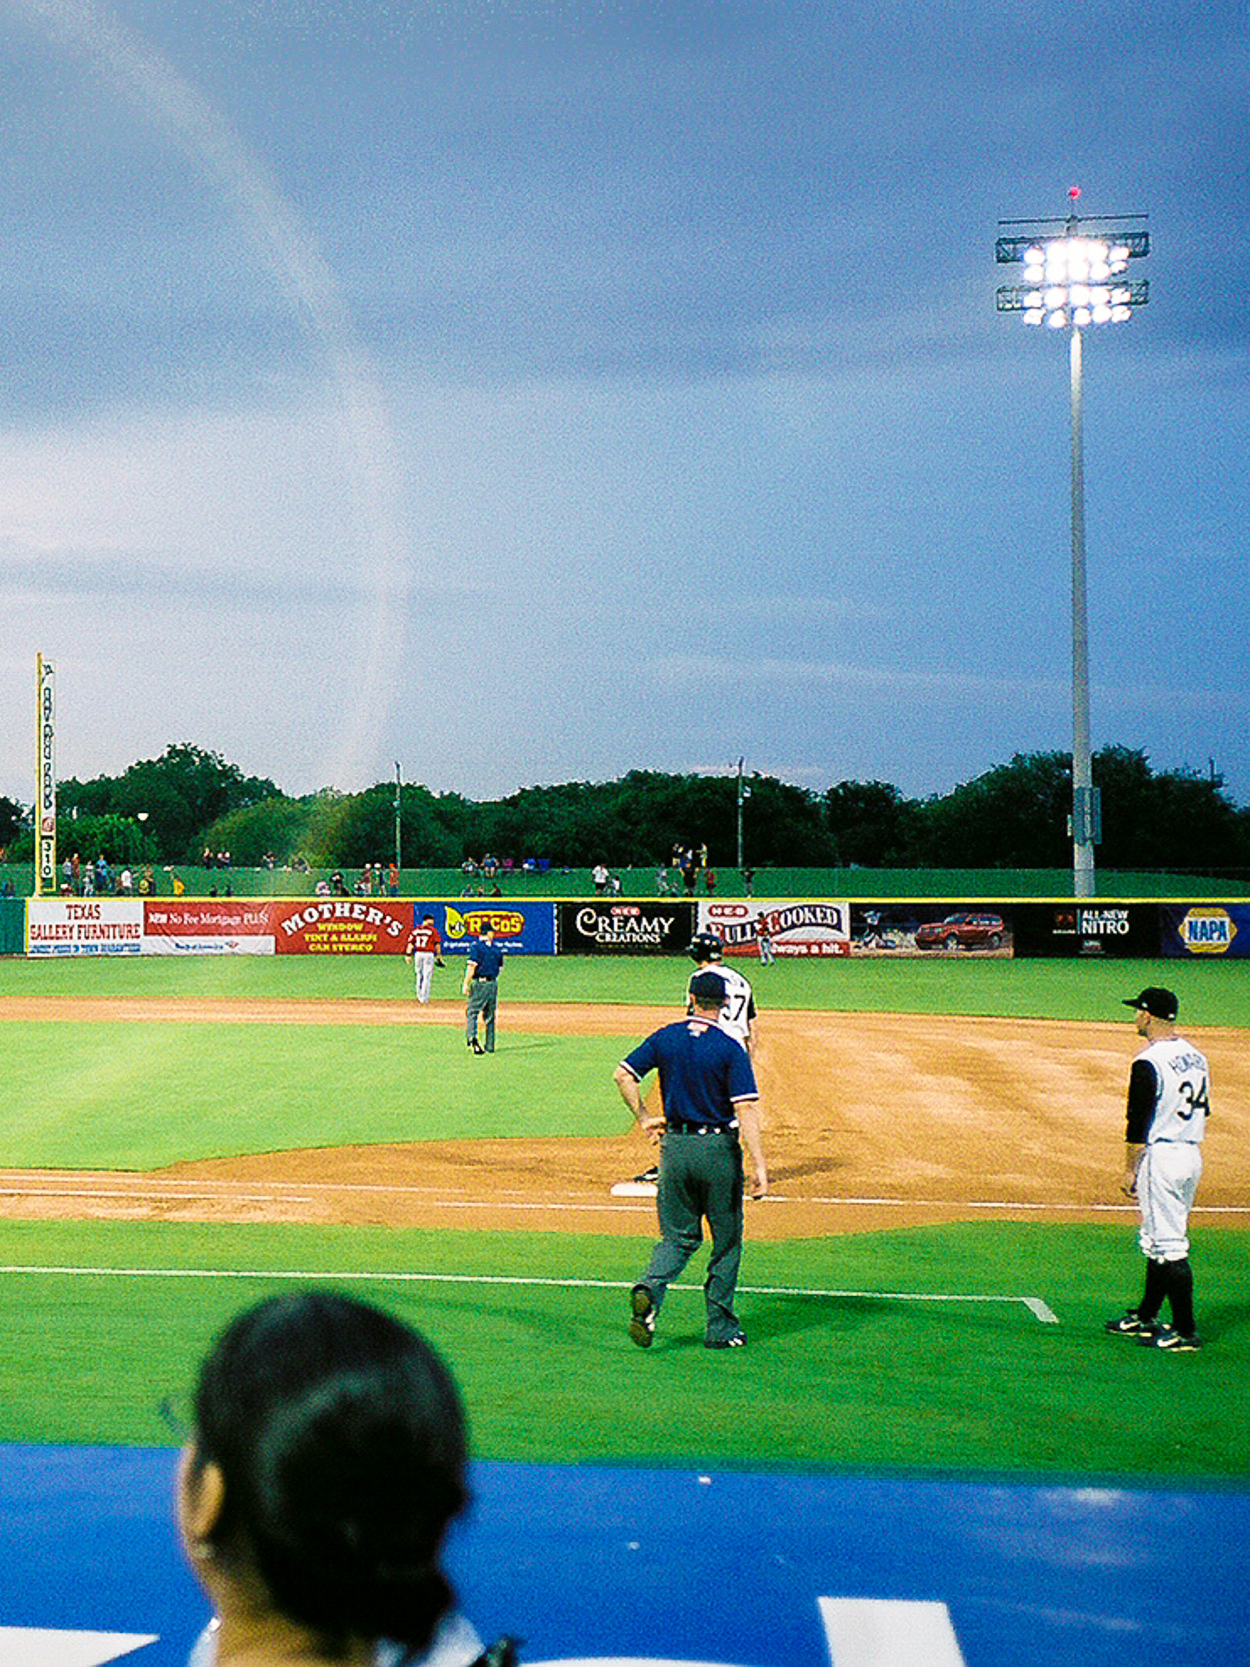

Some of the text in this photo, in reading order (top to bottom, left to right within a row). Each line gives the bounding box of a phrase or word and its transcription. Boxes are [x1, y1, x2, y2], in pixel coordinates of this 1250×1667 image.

[43, 841, 53, 876] 310
[66, 904, 101, 920] TEXAS
[170, 912, 183, 924] No
[183, 912, 199, 924] Fee
[200, 912, 242, 926] Mortgage
[281, 902, 404, 936] MOTHER'S
[766, 906, 838, 934] COOKED
[1082, 910, 1129, 919] ALL-NEW
[576, 907, 675, 936] CREAMY
[1082, 920, 1130, 935] NITRO
[77, 923, 141, 940] FURNITURE
[595, 932, 662, 944] CREATIONS
[710, 922, 759, 944] FULL
[1188, 920, 1228, 941] NAPA
[332, 943, 374, 952] STEREO
[415, 935, 429, 948] 17
[810, 944, 820, 954] a
[822, 943, 845, 954] hit.
[1177, 1076, 1211, 1121] 34
